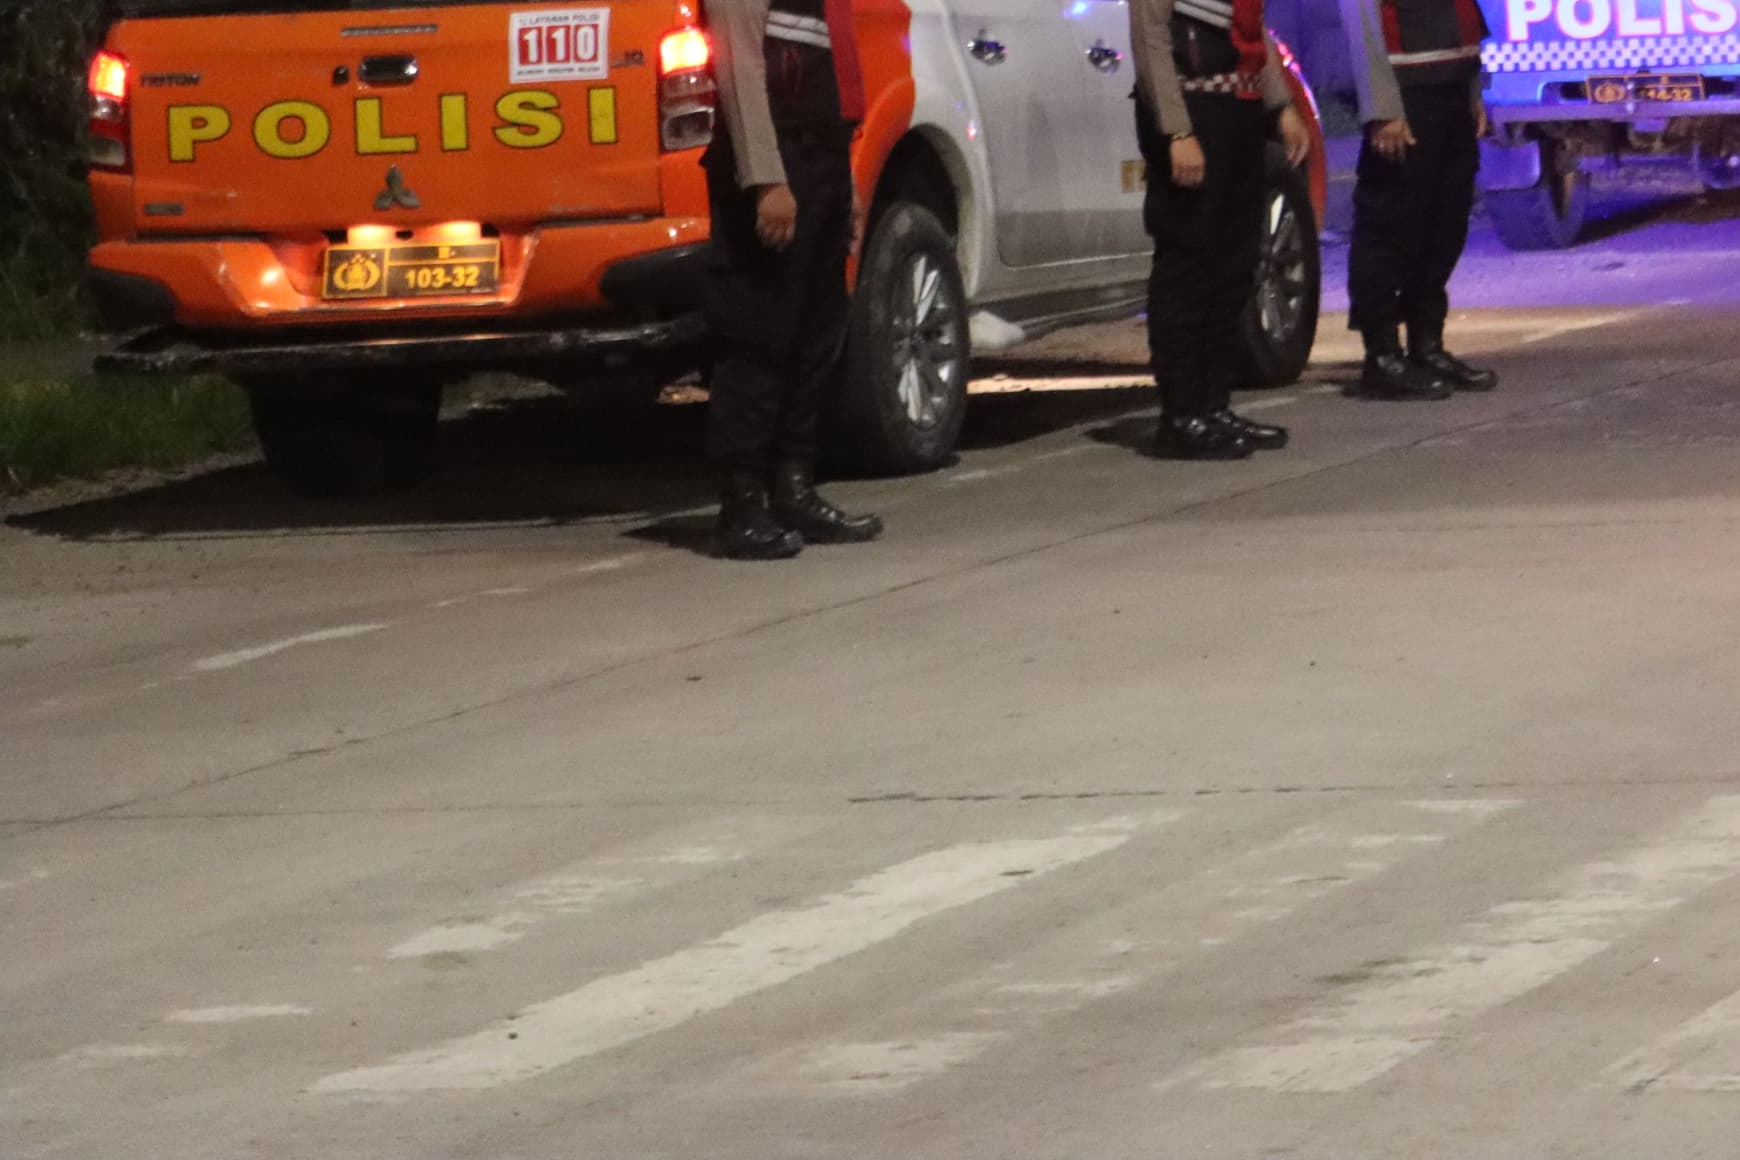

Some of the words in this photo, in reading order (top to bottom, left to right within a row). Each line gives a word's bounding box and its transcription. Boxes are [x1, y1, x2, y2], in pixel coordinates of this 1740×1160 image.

[523, 26, 596, 63] 110
[168, 86, 618, 162] POLISI
[404, 265, 480, 289] 103-32
